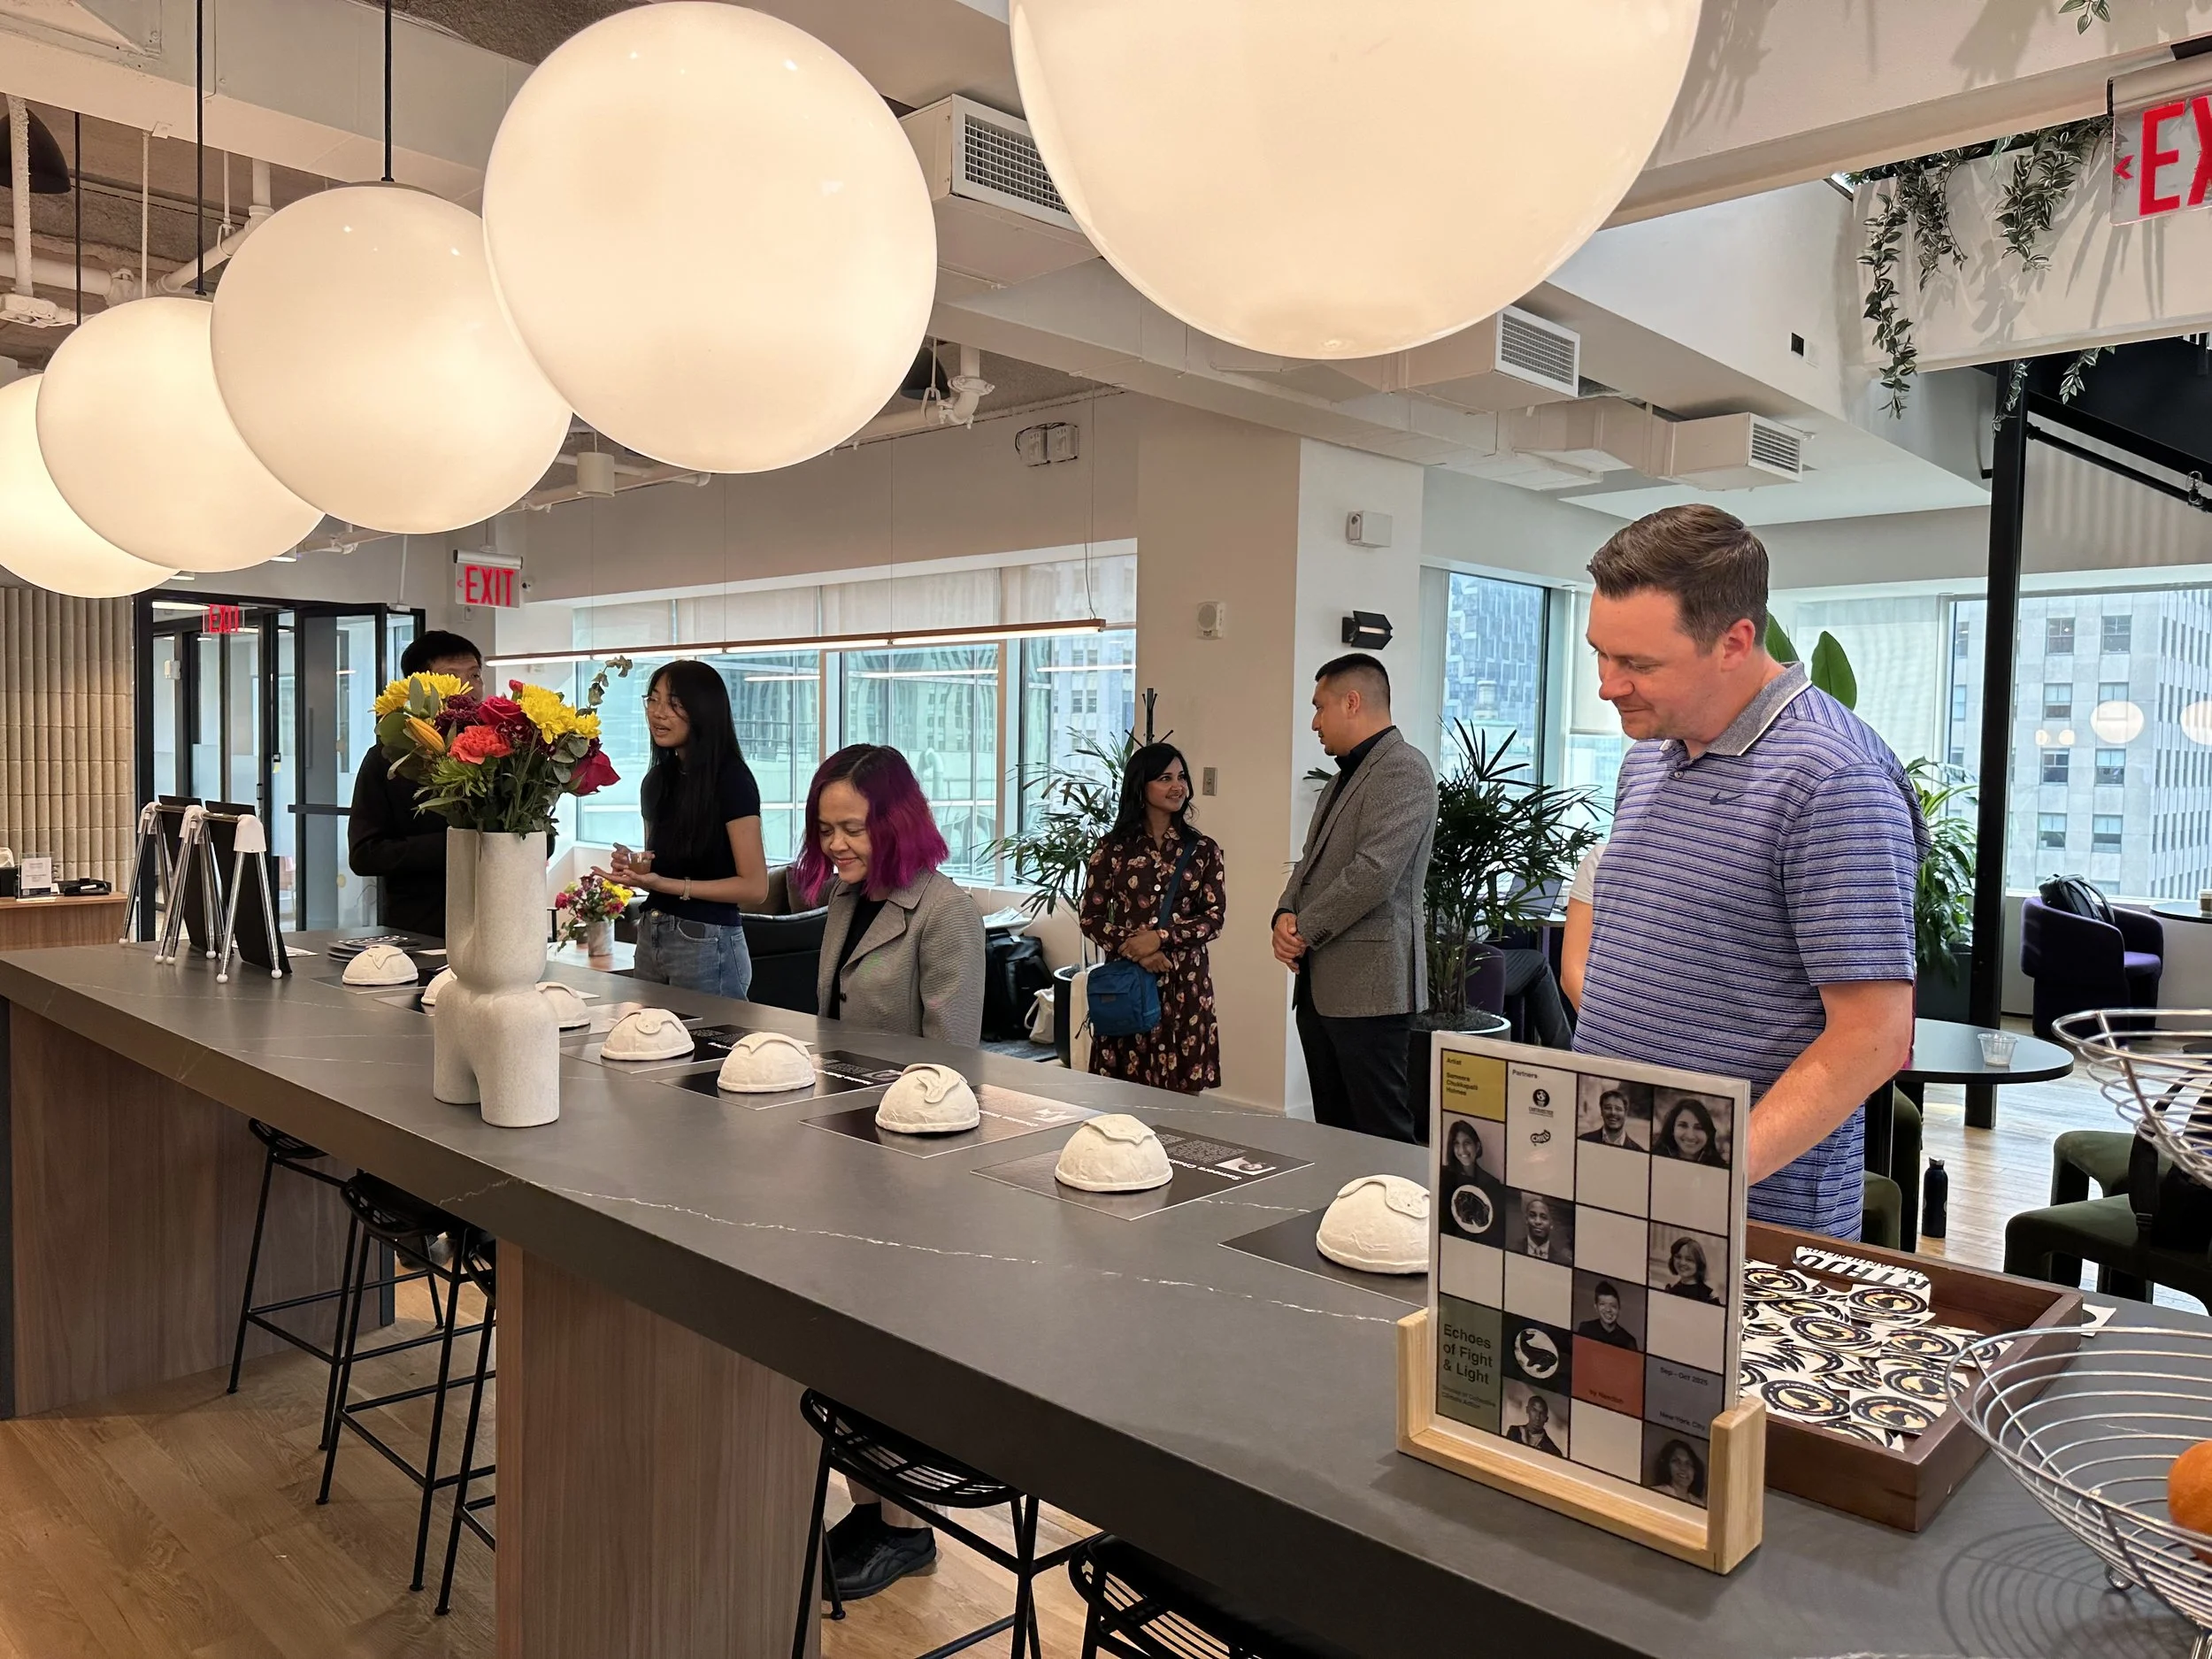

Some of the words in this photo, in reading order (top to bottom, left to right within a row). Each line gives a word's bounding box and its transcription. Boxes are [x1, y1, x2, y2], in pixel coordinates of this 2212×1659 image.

[465, 565, 515, 607] EXIT
[1512, 1070, 1538, 1079] Partners
[1443, 1324, 1491, 1349] Echoes
[1443, 1343, 1455, 1355] of
[1460, 1346, 1494, 1368] Fight
[1443, 1358, 1452, 1371] &
[1456, 1363, 1489, 1384] Light
[1660, 1366, 1673, 1377] Sep
[1678, 1372, 1691, 1381] Oct
[1692, 1376, 1709, 1386] 2025
[1659, 1410, 1674, 1421] New
[1674, 1416, 1690, 1426] York
[1692, 1420, 1706, 1432] City
